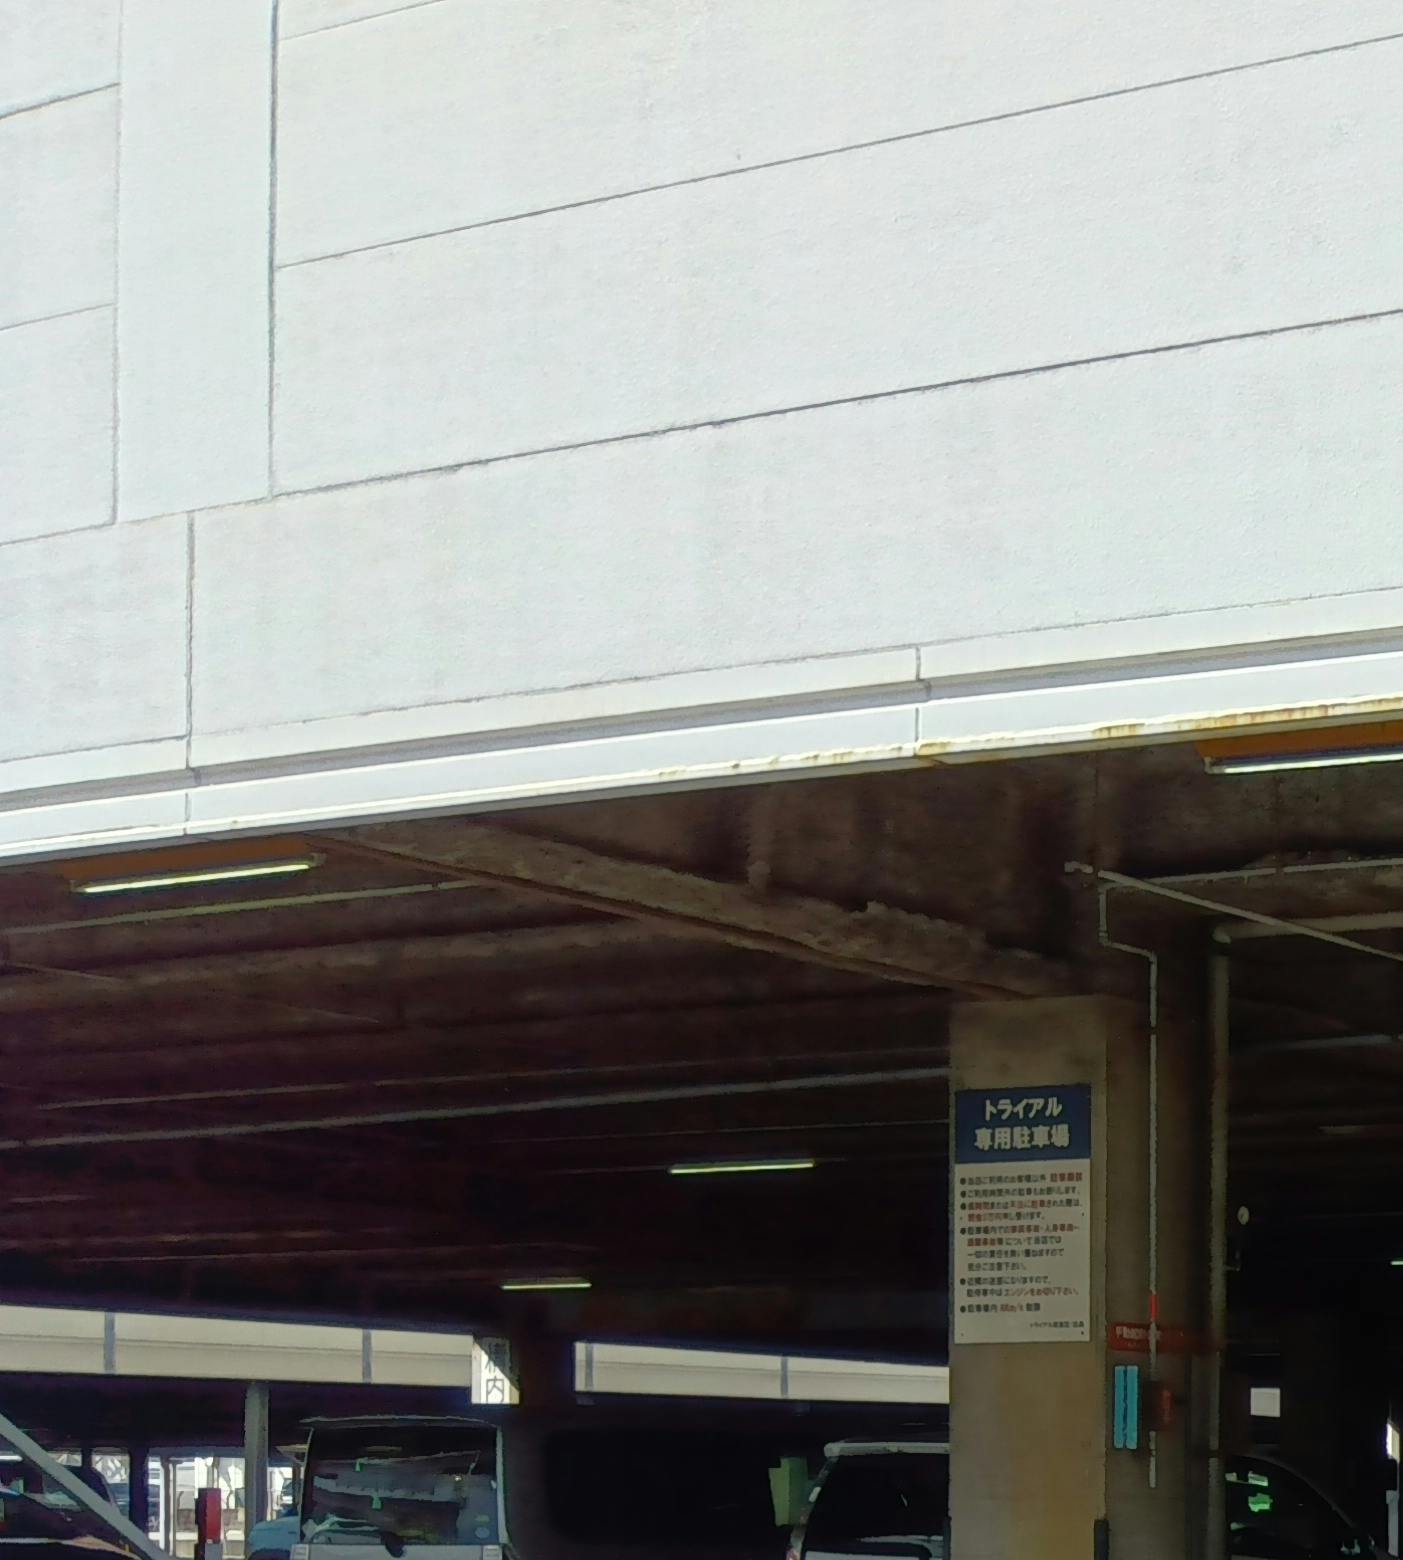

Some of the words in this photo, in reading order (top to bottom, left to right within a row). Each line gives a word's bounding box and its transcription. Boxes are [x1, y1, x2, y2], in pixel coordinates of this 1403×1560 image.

[984, 1096, 1062, 1121] トライアル
[974, 1124, 1071, 1151] 専用駐車場
